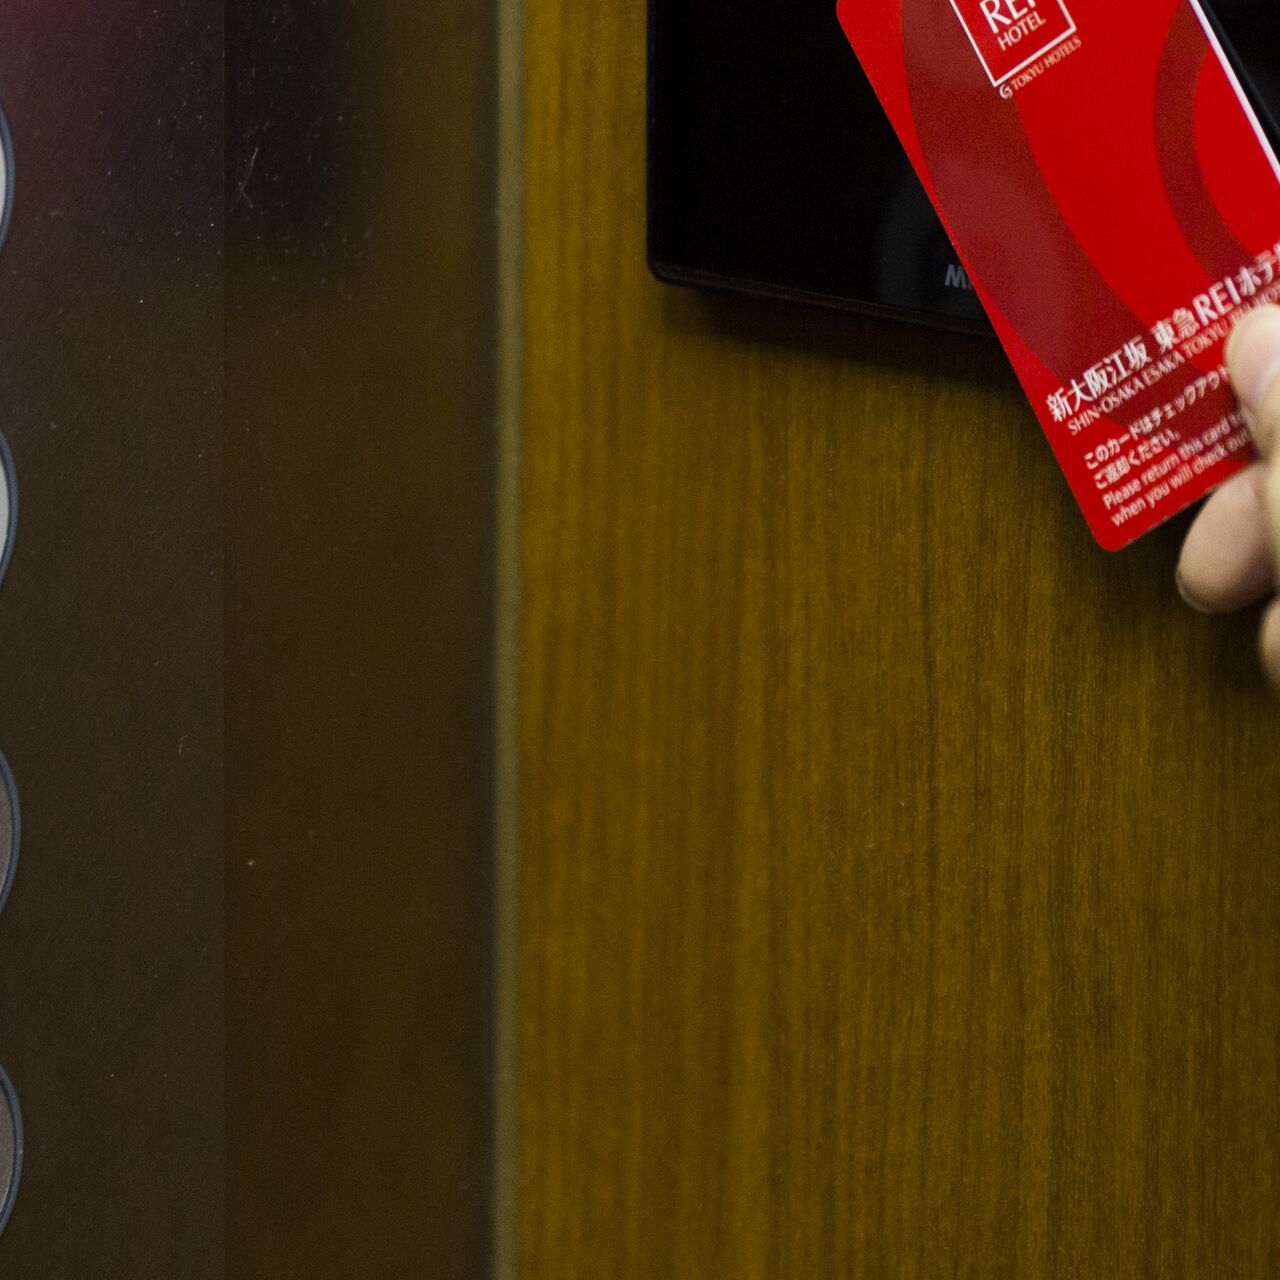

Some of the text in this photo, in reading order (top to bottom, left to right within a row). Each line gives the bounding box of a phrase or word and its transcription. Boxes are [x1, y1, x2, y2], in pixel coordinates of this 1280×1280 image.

[997, 10, 1047, 52] HOTEL
[1010, 35, 1082, 92] TOKYU HOTELS
[1045, 335, 1151, 423] 新大阪江坂
[1066, 376, 1146, 436] SHIN-OSAKA
[1141, 350, 1186, 387] ESAKA
[1101, 477, 1143, 511] Please
[1140, 452, 1181, 486] return
[1177, 437, 1205, 462] this
[1201, 416, 1232, 446] card
[1110, 496, 1147, 528] when
[1144, 482, 1171, 510] you
[1167, 462, 1194, 489] will
[1190, 441, 1228, 475] check
